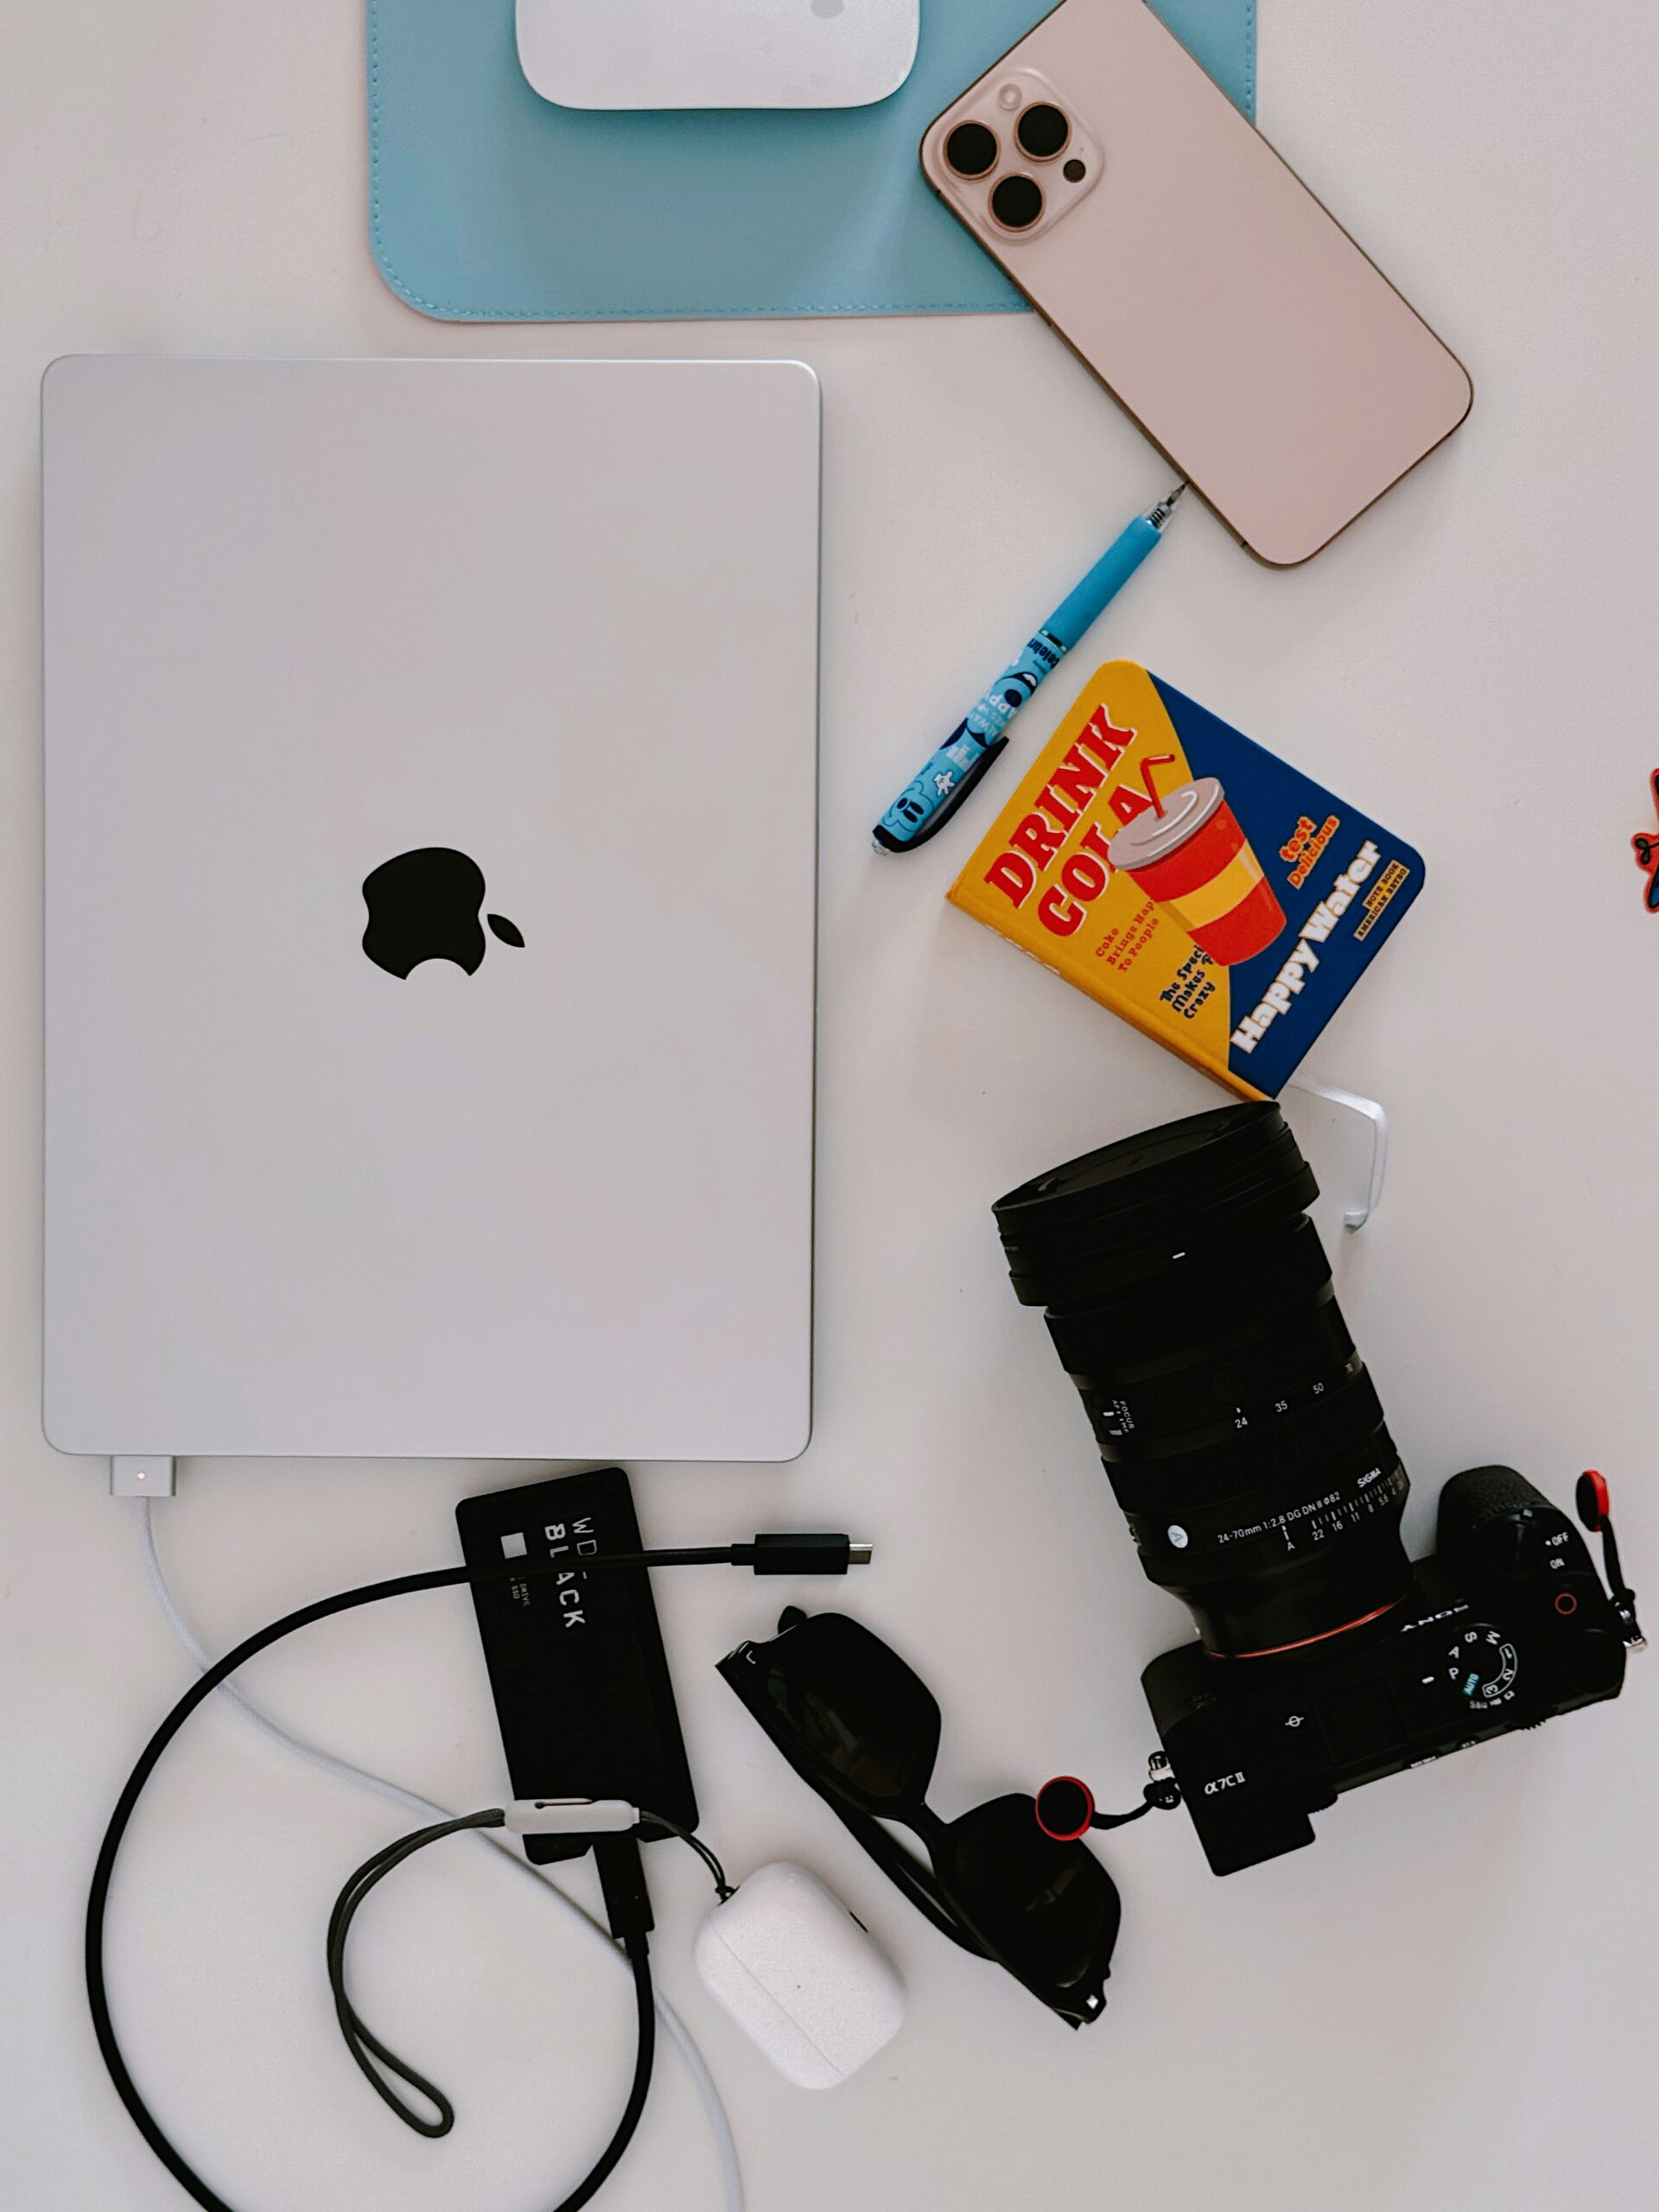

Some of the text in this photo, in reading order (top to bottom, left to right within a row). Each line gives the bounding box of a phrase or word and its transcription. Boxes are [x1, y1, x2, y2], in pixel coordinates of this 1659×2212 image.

[983, 702, 1138, 908] DRINK
[1280, 817, 1317, 861] test
[1287, 816, 1340, 889] Delicious
[1381, 863, 1399, 885] BOOK
[1357, 868, 1407, 937] AMERICAN RETRO
[1096, 928, 1119, 957] Coke
[1106, 925, 1137, 965] Brings
[1118, 918, 1160, 972] To People
[1230, 840, 1382, 1054] Happy Water
[1160, 982, 1181, 1001] The
[1172, 969, 1205, 1012] Makes
[1184, 982, 1216, 1019] Crazy
[1313, 1382, 1325, 1395] 50
[1120, 1401, 1135, 1429] FOCUS
[1274, 1401, 1288, 1413] 35
[1235, 1416, 1248, 1429] 24
[1357, 1467, 1382, 1488] SIGMA
[1217, 1524, 1262, 1543] 24-70mm
[1263, 1515, 1286, 1529] 1:2.8
[1287, 1510, 1301, 1522] DG
[1302, 1503, 1317, 1515] DN
[1287, 1541, 1295, 1552] A
[1312, 1529, 1325, 1541] 22
[1332, 1520, 1344, 1532] 16
[1351, 1511, 1361, 1522] 11
[1551, 1532, 1569, 1547] OFF
[1549, 1557, 1565, 1570] ON
[544, 1523, 586, 1628] BLACK
[1464, 1631, 1478, 1643] S
[1485, 1630, 1501, 1645] M
[1448, 1646, 1459, 1659] A
[1448, 1668, 1459, 1680] P
[1463, 1673, 1479, 1695] AUTO
[1502, 1669, 1514, 1681] 2
[1485, 1684, 1498, 1694] 3
